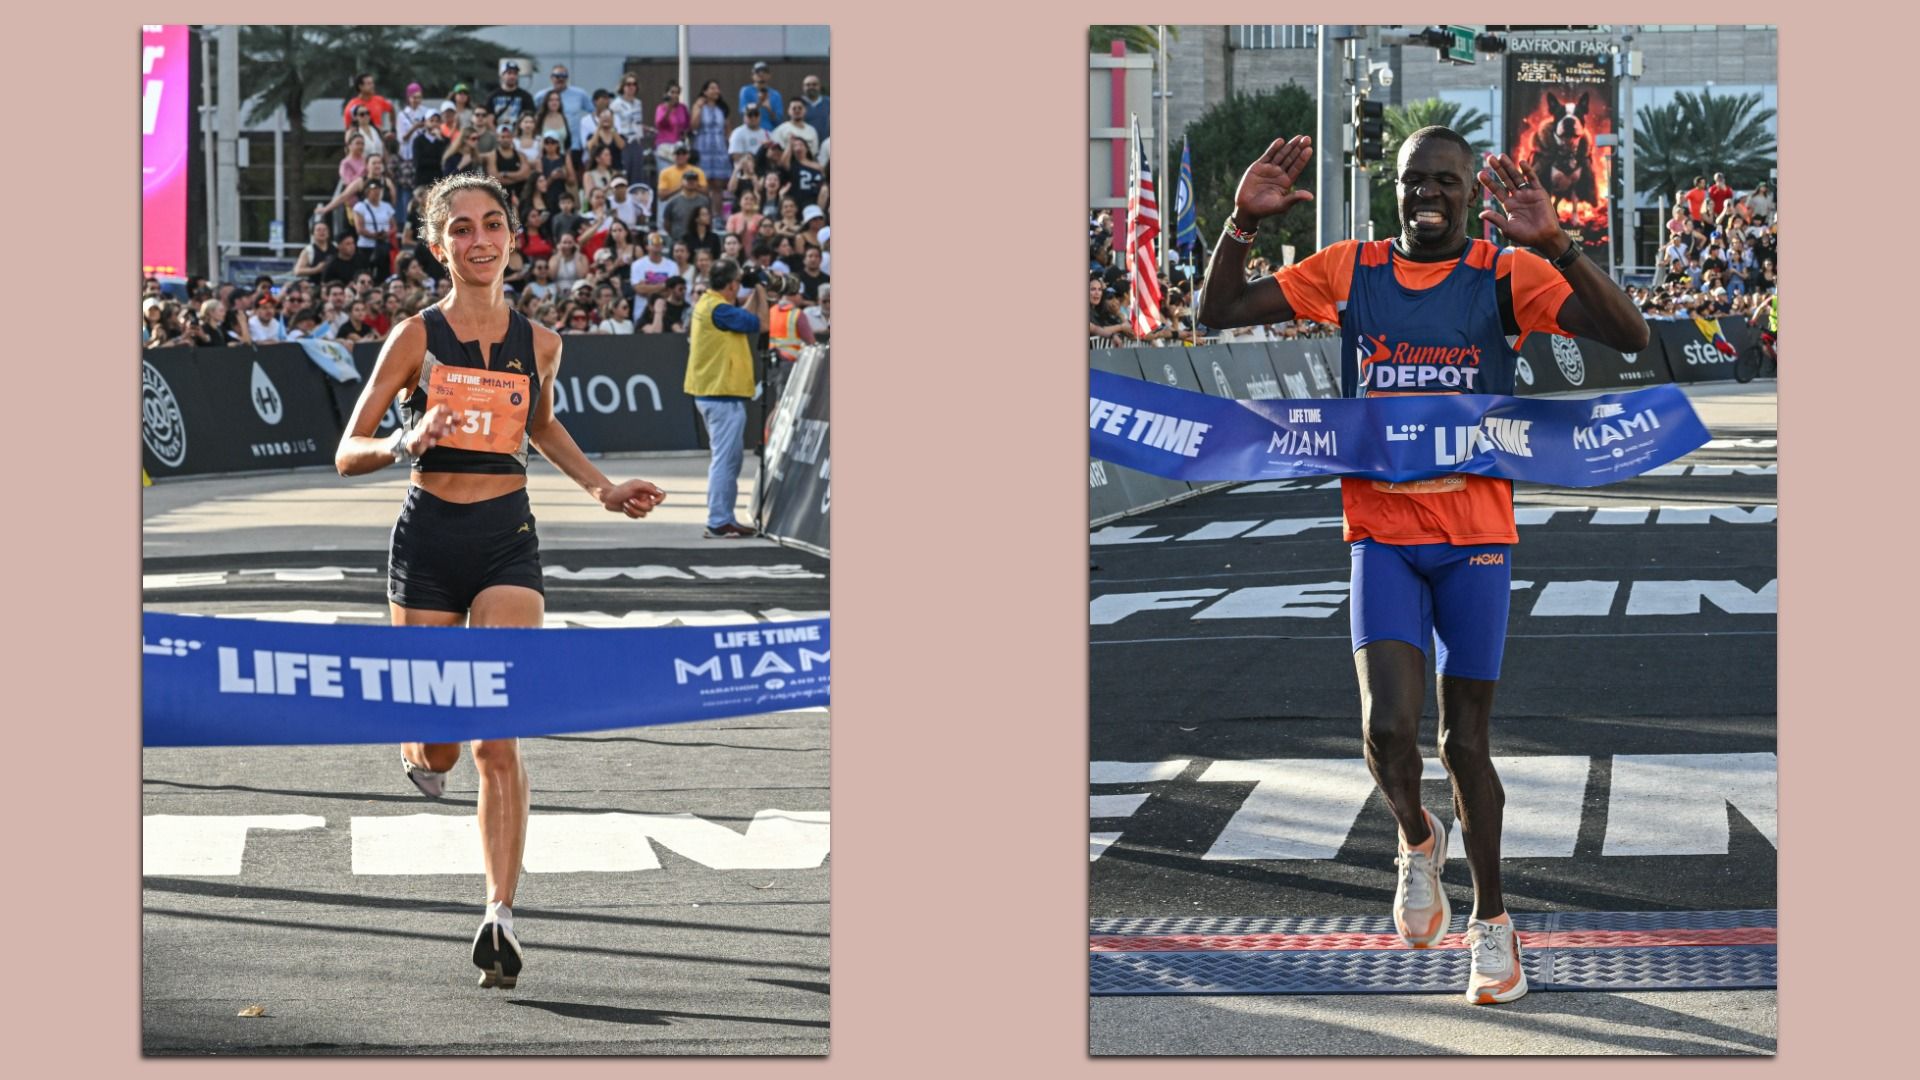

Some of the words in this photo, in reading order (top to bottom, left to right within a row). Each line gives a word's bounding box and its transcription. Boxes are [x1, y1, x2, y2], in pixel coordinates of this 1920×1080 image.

[1511, 38, 1577, 54] BAYFRONT
[1580, 40, 1612, 55] PARK
[1517, 71, 1562, 82] MERLIN
[1521, 62, 1547, 72] RISE
[1392, 342, 1482, 367] Runner's
[447, 373, 461, 383] LIFE
[461, 375, 481, 385] TIME
[482, 378, 515, 389] MIAMI
[1376, 365, 1479, 390] DEPOT
[461, 409, 493, 436] 31
[1289, 408, 1304, 423] LIFE
[1303, 408, 1322, 423] TIME
[1127, 408, 1210, 457] TIME
[1484, 416, 1534, 458] TIME
[1572, 408, 1661, 450] MIAMI
[251, 438, 317, 457] HYDROJUG
[1266, 430, 1338, 457] MIAMI
[1469, 553, 1505, 566] HOKA
[713, 630, 762, 649] LIFE
[761, 625, 821, 645] TIME
[218, 646, 344, 699] LIFE
[349, 657, 510, 708] TIME
